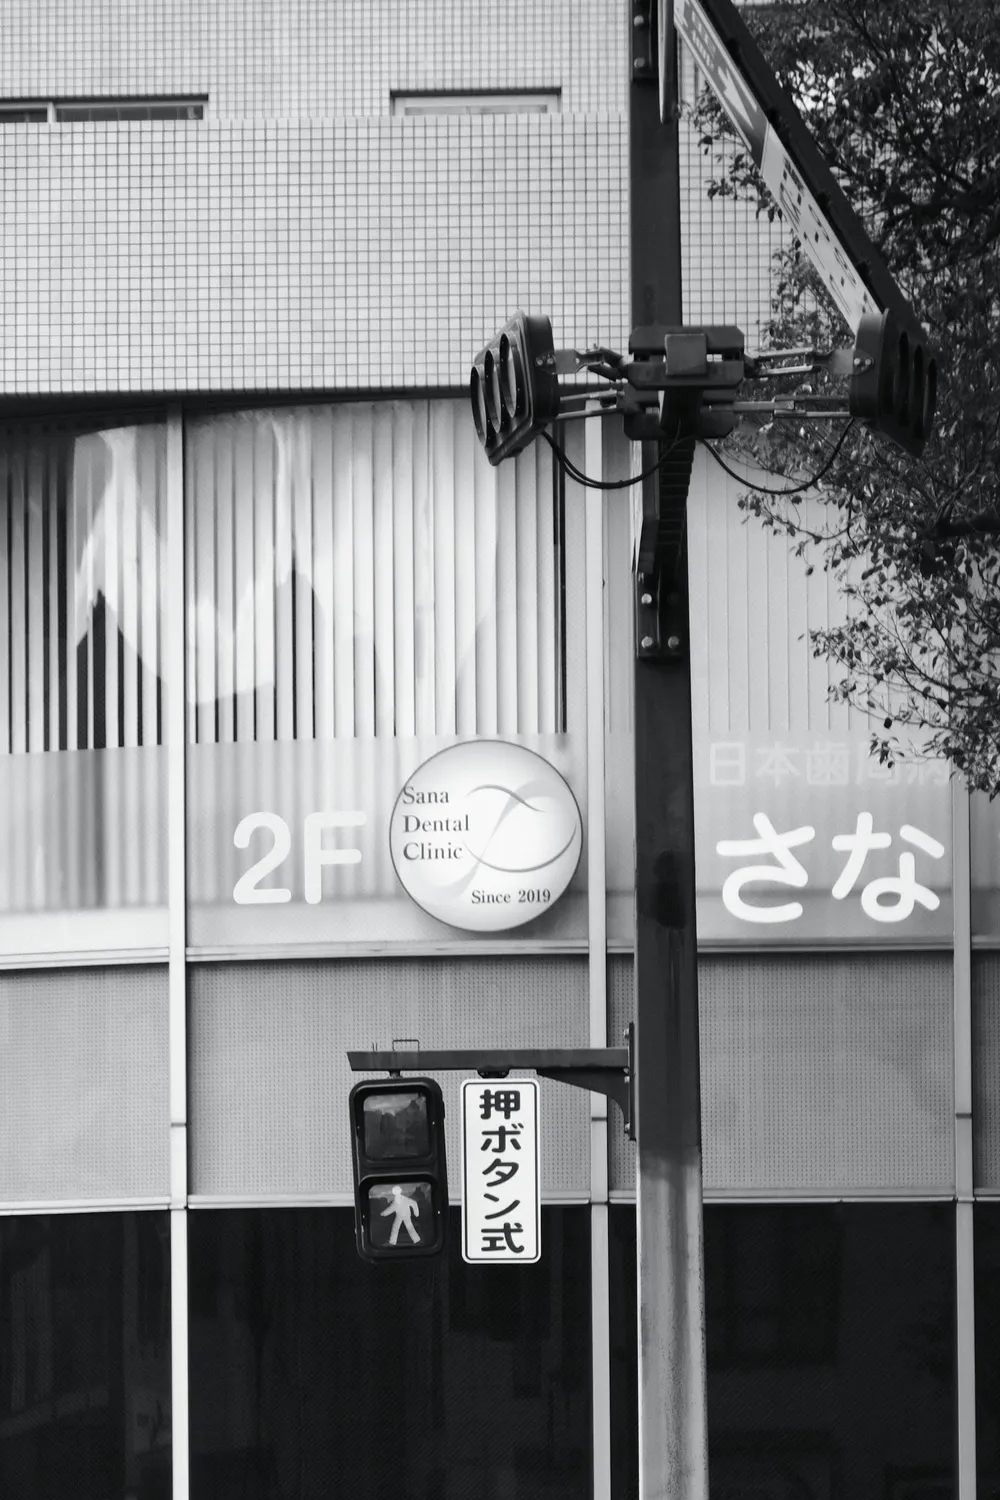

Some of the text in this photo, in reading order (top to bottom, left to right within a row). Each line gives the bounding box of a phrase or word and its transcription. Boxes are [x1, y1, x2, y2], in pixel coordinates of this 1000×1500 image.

[402, 785, 450, 805] Sana
[402, 814, 470, 834] Dental
[232, 810, 368, 905] 2F
[402, 841, 464, 861] Clinic
[716, 811, 946, 923] さな
[471, 888, 551, 904] Since 2019
[479, 1088, 525, 1254] 押ボタン式
